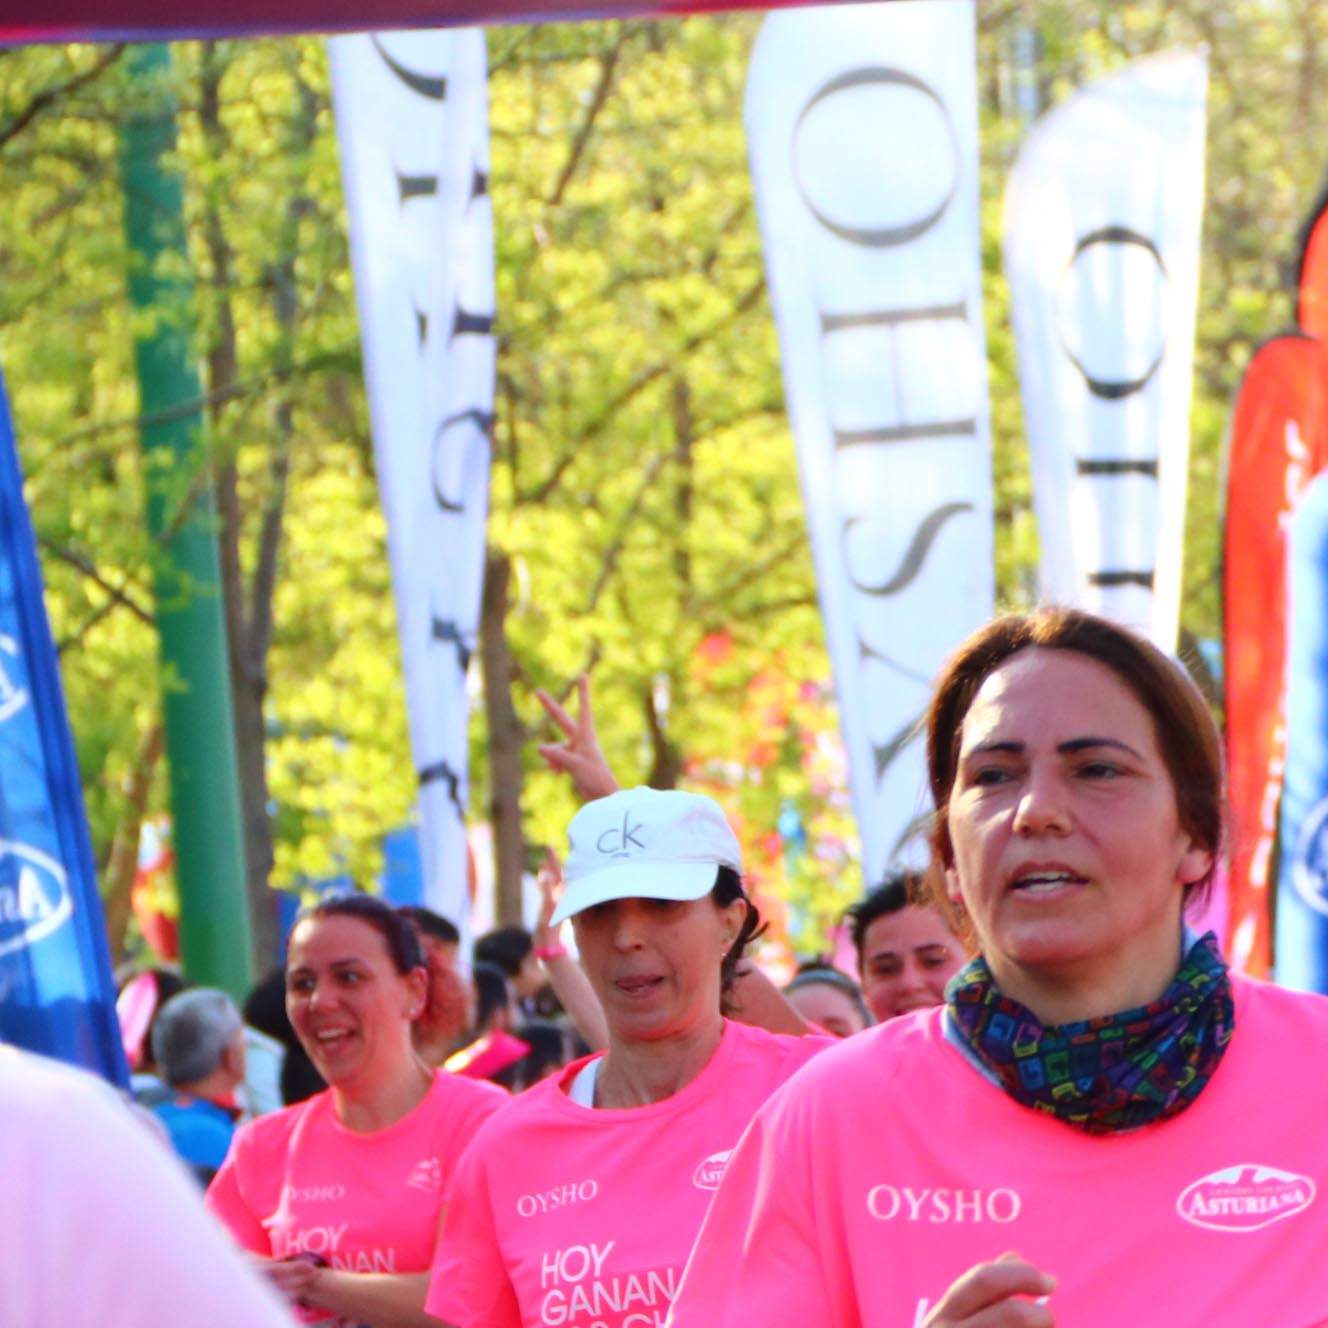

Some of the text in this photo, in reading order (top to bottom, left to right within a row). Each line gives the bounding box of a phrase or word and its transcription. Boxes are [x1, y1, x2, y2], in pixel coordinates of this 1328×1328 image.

[517, 1178, 598, 1218] OYSHO
[866, 1184, 1022, 1224] OYSHO
[1189, 1186, 1306, 1220] ASTURIANA
[285, 1223, 348, 1254] HOY
[540, 1240, 616, 1289] HOY
[540, 1267, 677, 1327] GANAN
